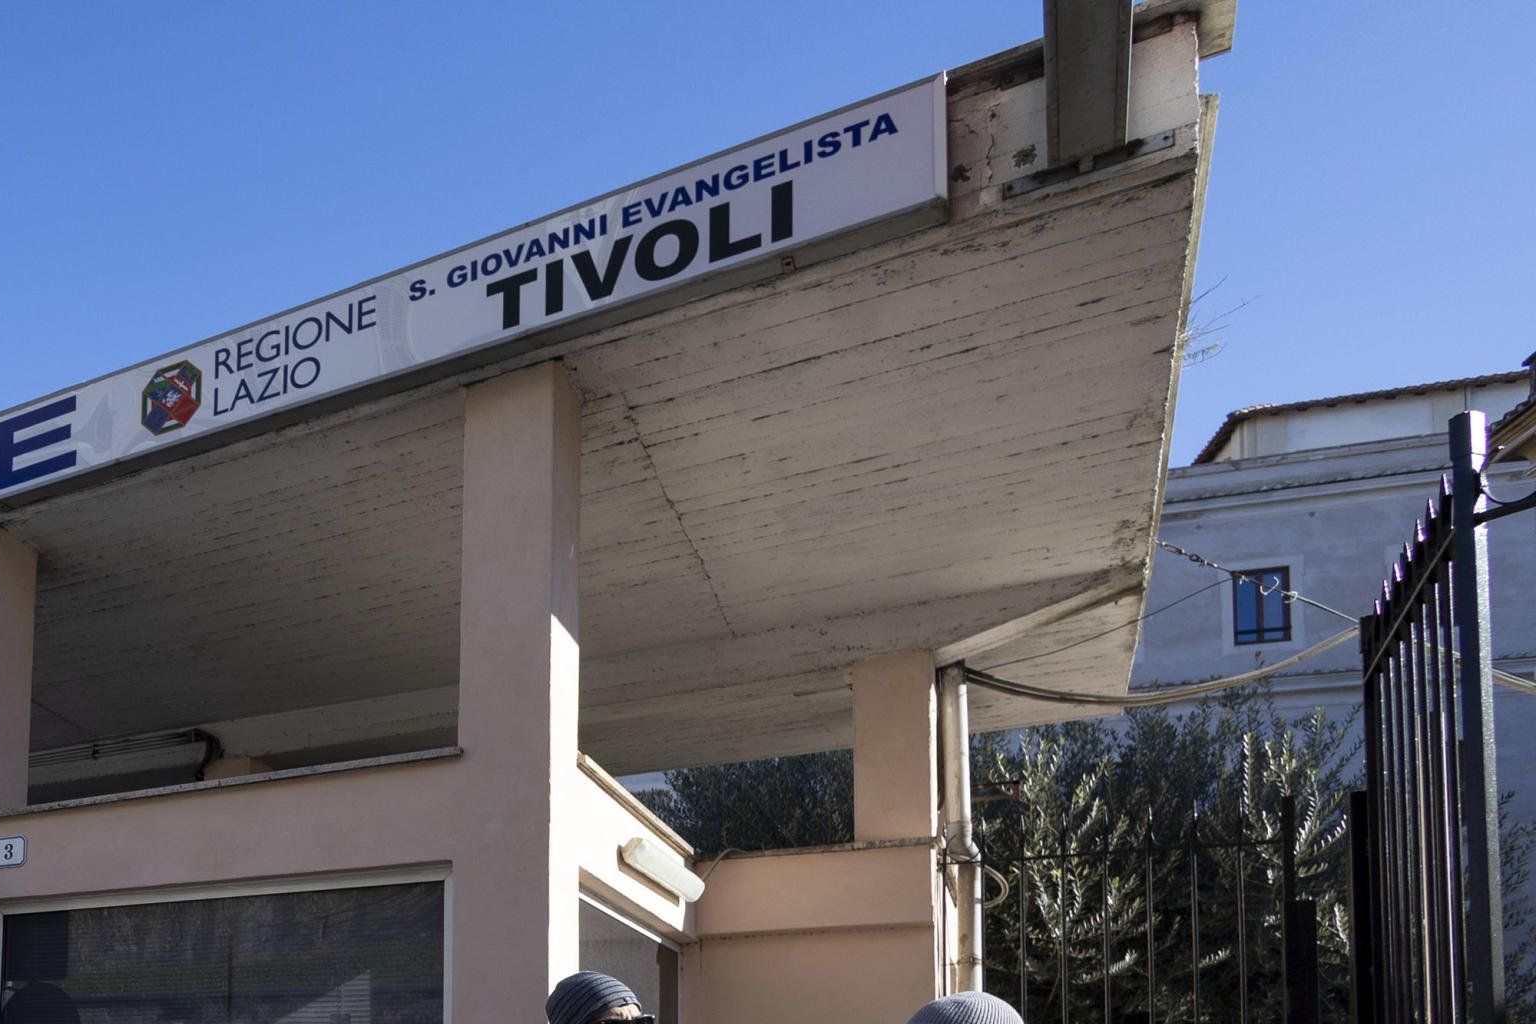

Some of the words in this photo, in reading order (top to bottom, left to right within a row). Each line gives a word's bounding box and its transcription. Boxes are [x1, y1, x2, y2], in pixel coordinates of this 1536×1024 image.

[408, 278, 436, 302] S.
[447, 213, 608, 290] GIOVANNI
[621, 112, 898, 229] EVANGELISTA
[486, 179, 794, 331] TIVOLI
[214, 295, 377, 379] REGIONE
[213, 356, 321, 417] LAZIO
[4, 843, 14, 860] 3
